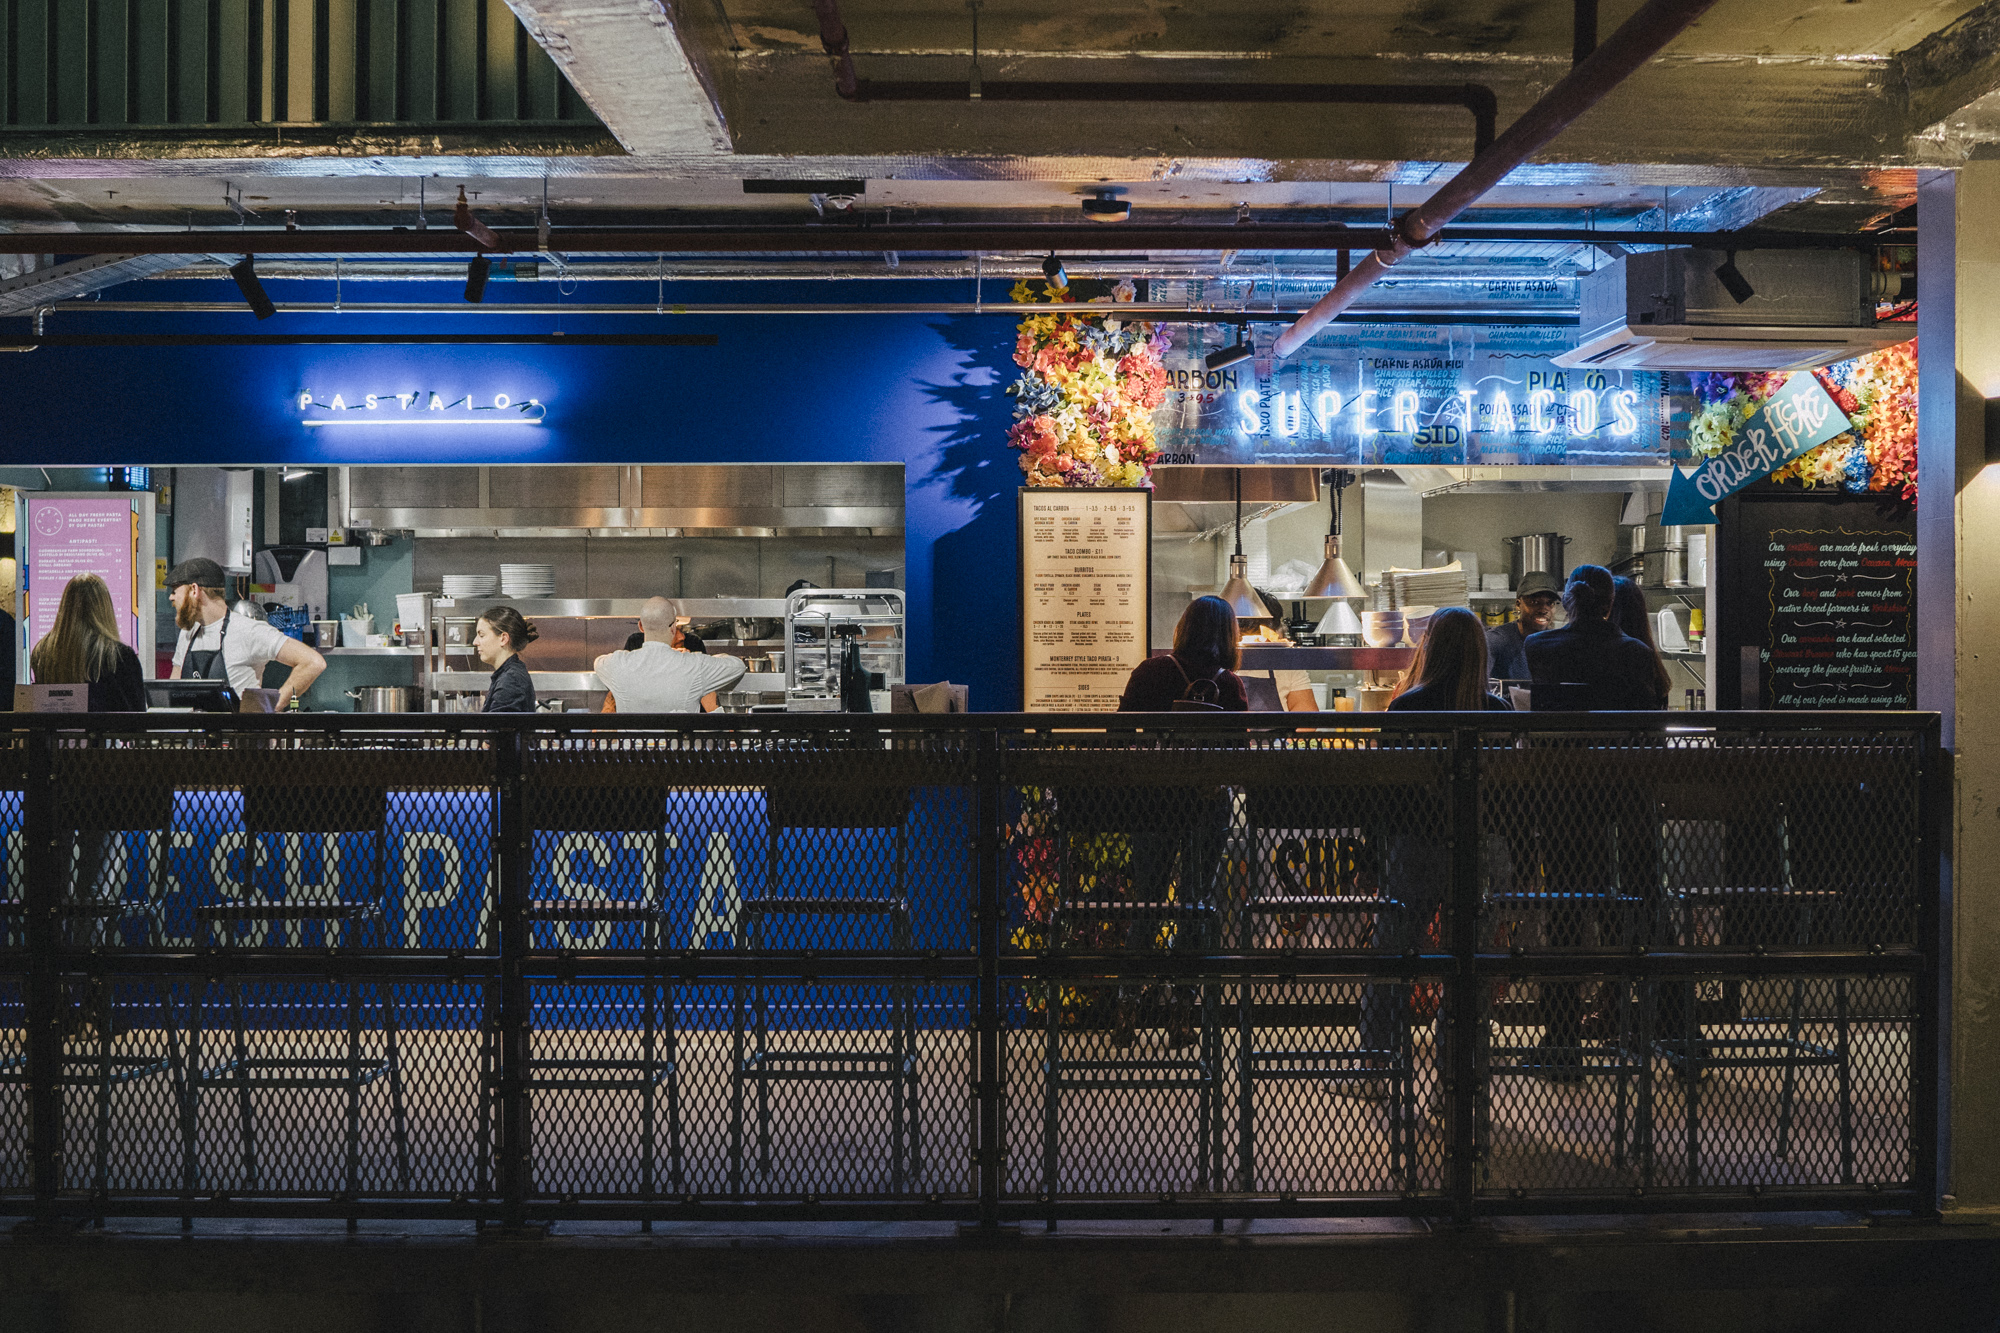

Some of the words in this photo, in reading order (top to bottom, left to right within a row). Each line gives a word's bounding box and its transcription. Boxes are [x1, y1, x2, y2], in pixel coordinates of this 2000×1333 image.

[1489, 280, 1521, 292] CARNE
[1524, 280, 1558, 292] ASADA
[1374, 358, 1410, 369] CARNE
[1412, 358, 1443, 369] ASADA
[1445, 359, 1464, 369] RIC
[1165, 369, 1238, 391] ARBON
[1374, 370, 1415, 378] CHARCOAL
[1416, 370, 1448, 378] GRILLED
[1374, 379, 1395, 388] SKIRT
[1425, 379, 1460, 388] ROASTED
[1527, 371, 1567, 394] PLA
[300, 393, 510, 411] PASTAIO
[1239, 389, 1420, 437] SUPER
[1458, 388, 1638, 437] TACOS
[1696, 428, 1779, 500] ORDER
[1763, 385, 1829, 459] HERE
[1157, 453, 1196, 465] ARBON
[1768, 542, 1785, 552] Our
[1819, 544, 1834, 552] are
[1835, 542, 1857, 552] made
[1857, 542, 1880, 555] fresh
[1881, 542, 1918, 556] everyday
[1764, 559, 1786, 571] using
[1837, 558, 1859, 570] from
[1894, 558, 1918, 567] Mexic
[1783, 588, 1800, 598] Our
[1819, 588, 1836, 598] and
[1857, 590, 1881, 598] comes
[1881, 588, 1903, 600] from
[1778, 603, 1801, 612] native
[1803, 603, 1826, 612] breed
[1826, 603, 1860, 616] farmers
[1861, 603, 1870, 612] in
[1781, 633, 1797, 643] Our
[1851, 633, 1873, 643] hand
[1874, 633, 1906, 643] selected
[1760, 649, 1770, 662] by
[1836, 648, 1851, 658] who
[1853, 648, 1868, 658] has
[1869, 649, 1892, 661] spent
[1892, 649, 1902, 658] 15
[1776, 664, 1811, 677] sourcing
[1812, 664, 1825, 673] the
[1825, 664, 1849, 677] finest
[1849, 664, 1873, 677] fruits
[1873, 665, 1882, 673] in
[1778, 695, 1791, 704] All
[1792, 695, 1801, 707] of
[1817, 694, 1837, 707] food
[1838, 695, 1846, 704] is
[1846, 694, 1869, 704] made
[1870, 695, 1893, 707] using
[1894, 694, 1907, 704] the
[402, 830, 757, 950] PSTA
